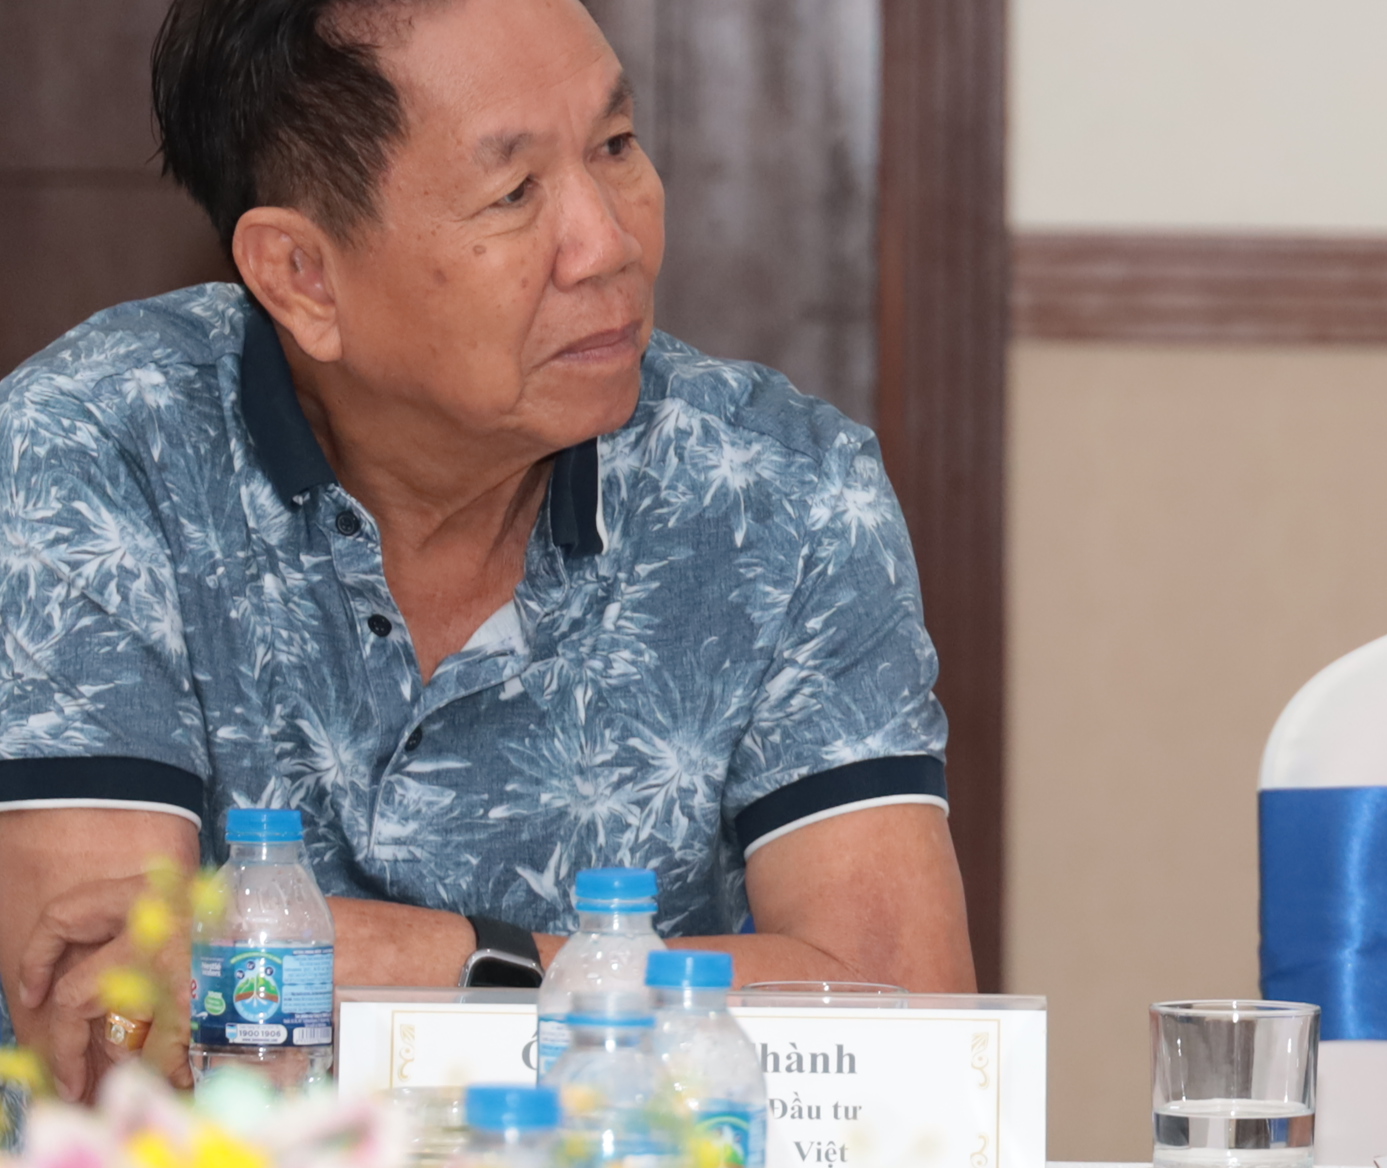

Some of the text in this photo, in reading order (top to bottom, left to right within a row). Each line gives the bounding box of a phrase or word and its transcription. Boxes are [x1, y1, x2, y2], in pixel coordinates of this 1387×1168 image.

[239, 1029, 281, 1038] 1900 1906
[760, 1042, 857, 1074] hành
[768, 1091, 862, 1121] Đầu tư
[793, 1141, 849, 1168] Việt
